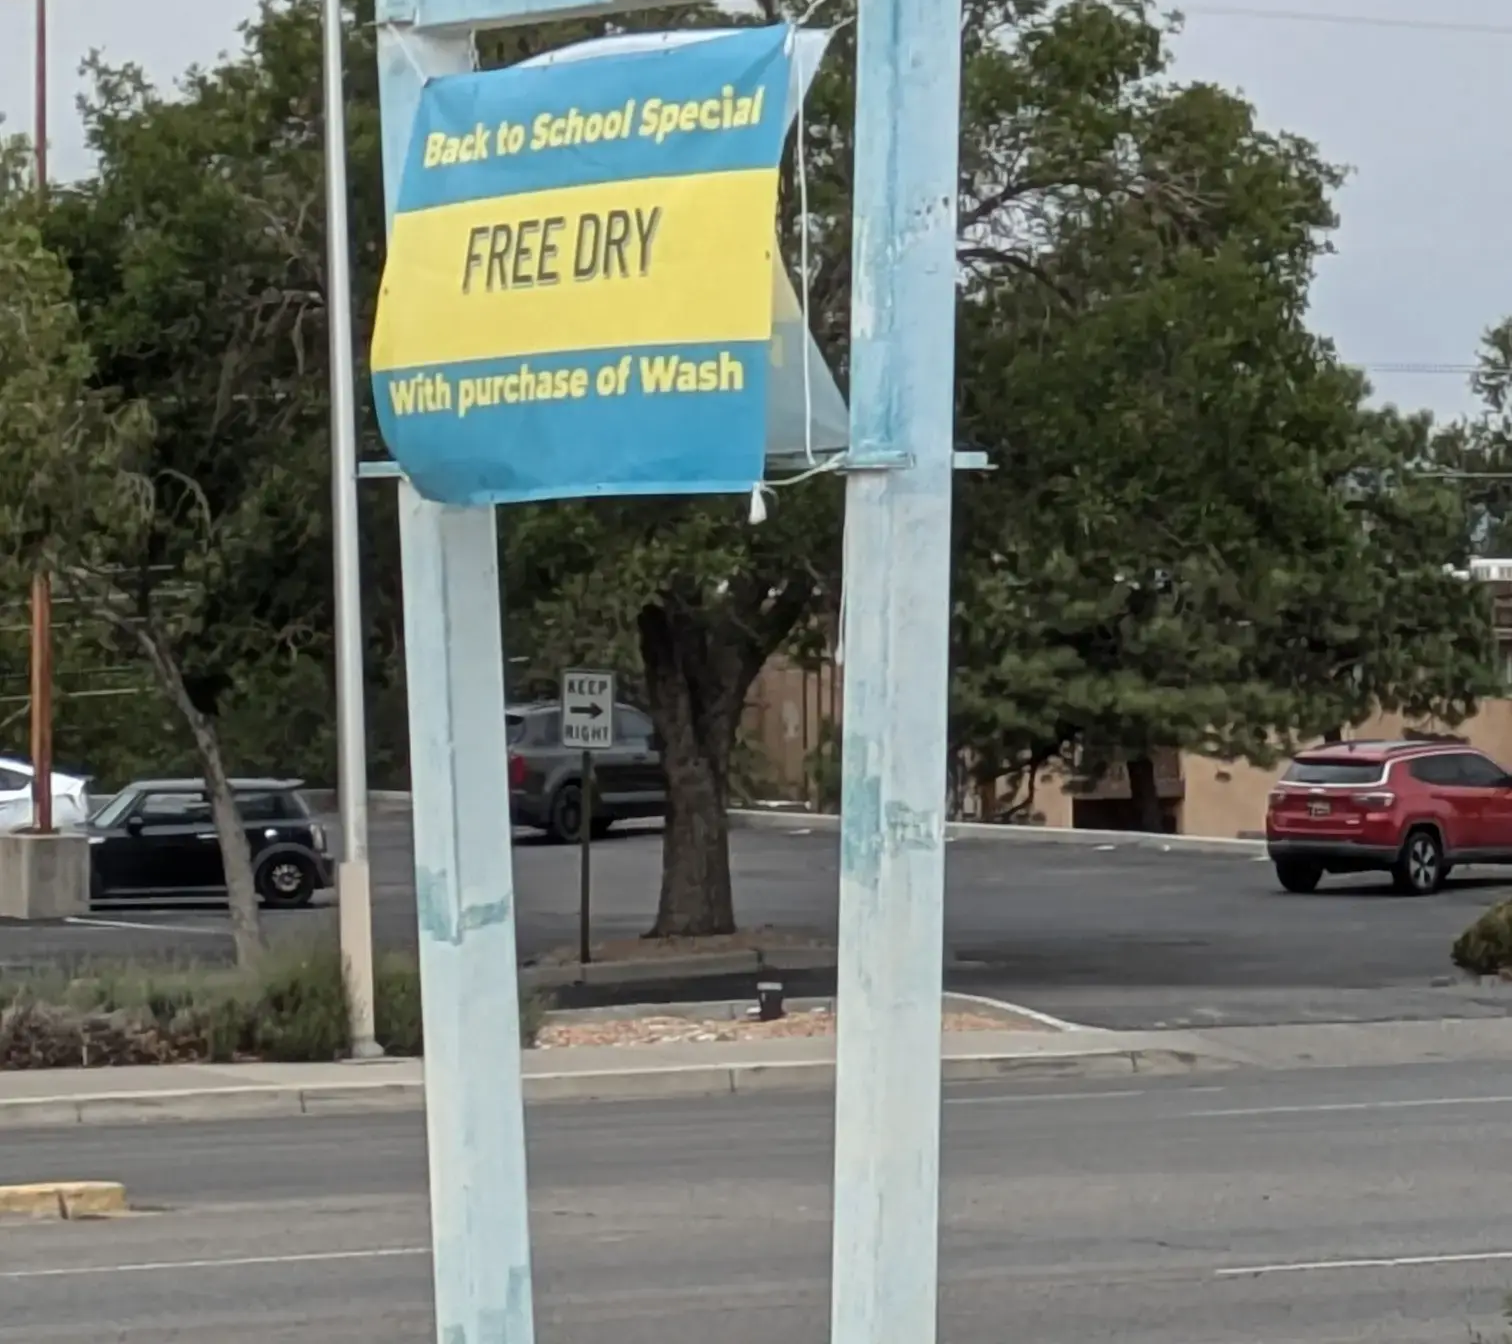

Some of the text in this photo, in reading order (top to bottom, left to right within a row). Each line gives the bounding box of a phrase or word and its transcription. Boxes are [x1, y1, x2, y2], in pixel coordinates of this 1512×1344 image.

[423, 85, 764, 168] Back to School Special
[462, 205, 663, 295] FREE DRY
[388, 351, 744, 418] With purchase of Wash
[568, 680, 607, 695] KEEP
[565, 724, 609, 743] RIGHT
